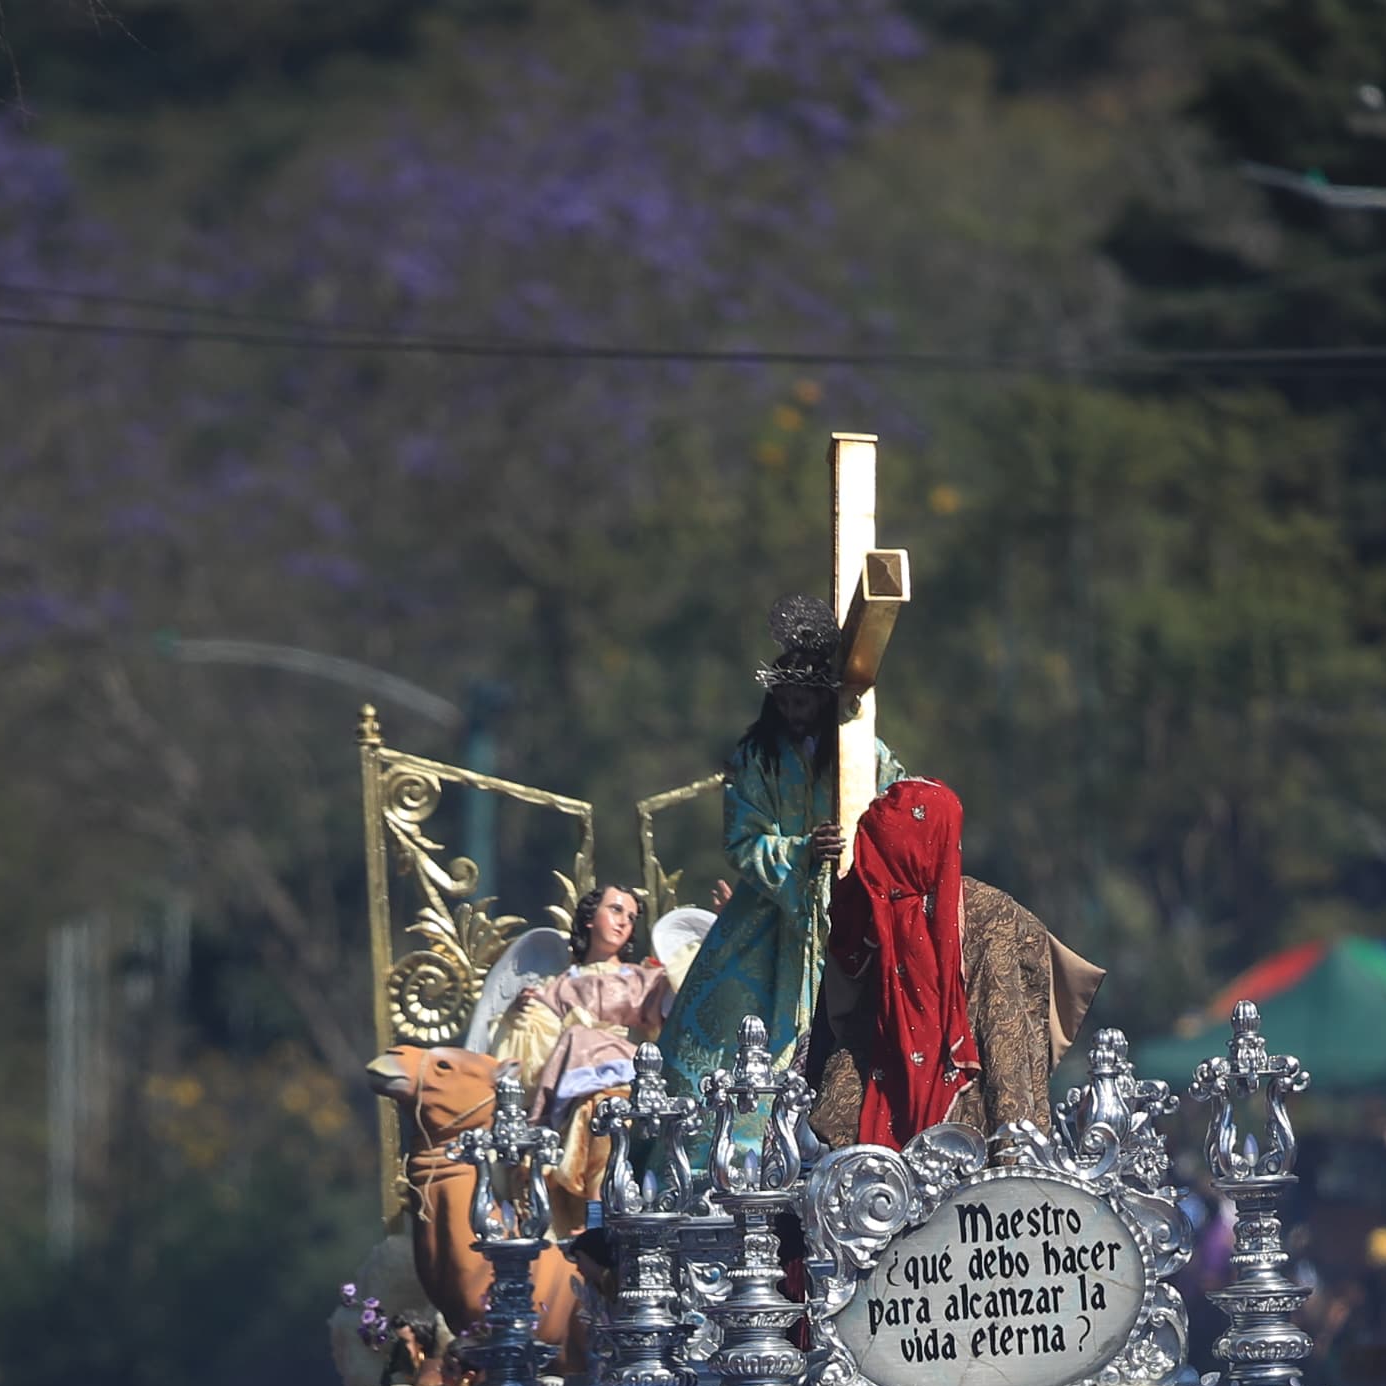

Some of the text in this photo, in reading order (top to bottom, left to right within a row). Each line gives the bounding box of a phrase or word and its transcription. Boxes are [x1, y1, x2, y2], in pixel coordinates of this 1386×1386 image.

[954, 1201, 1081, 1243] Maestro
[886, 1240, 1122, 1290] ¿qué debo hacer
[867, 1274, 1107, 1336] para alcanzar la
[900, 1328, 957, 1363] vida
[971, 1322, 1066, 1358] eterna
